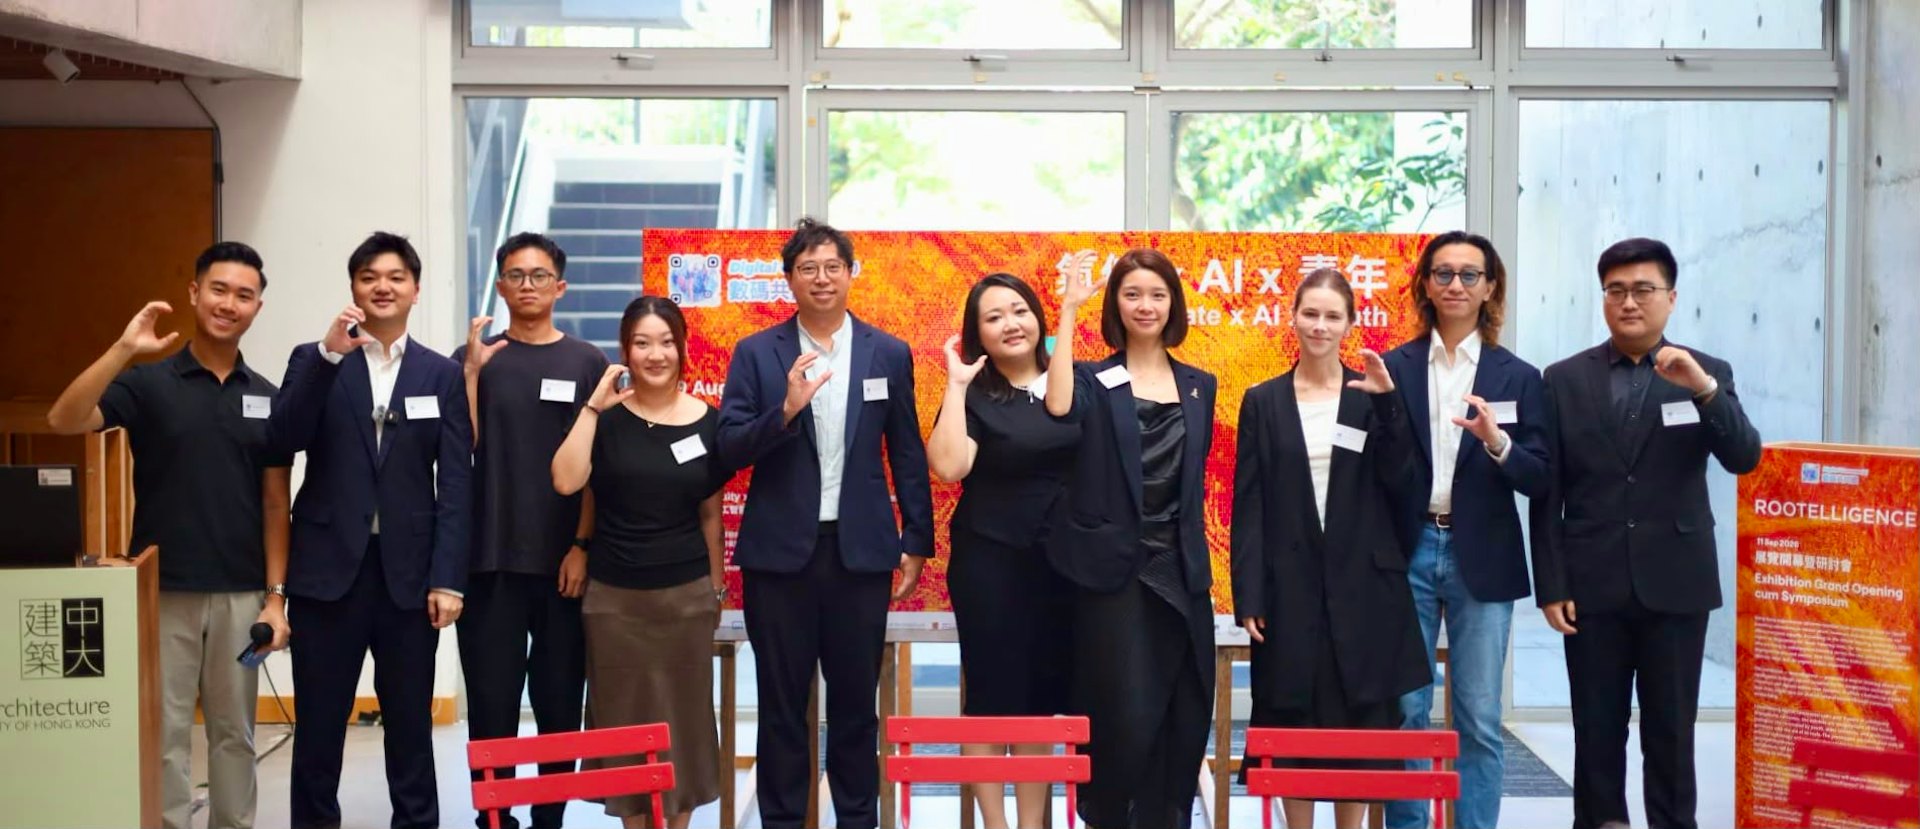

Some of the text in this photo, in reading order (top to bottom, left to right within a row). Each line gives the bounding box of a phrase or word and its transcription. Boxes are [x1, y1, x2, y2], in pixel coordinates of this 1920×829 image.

[729, 260, 778, 277] Digital
[1198, 259, 1243, 294] AI
[1257, 268, 1283, 294] x
[1229, 309, 1245, 326] x
[1252, 304, 1280, 326] AI
[1754, 498, 1917, 528] ROOTELLIGENCE
[1754, 572, 1904, 601] Exhibition Grand Opening
[1754, 590, 1848, 608] cum Symposium
[23, 601, 60, 677] 建築
[65, 600, 103, 676] 中大
[14, 720, 30, 731] OF
[33, 718, 73, 731] HONG
[75, 717, 111, 729] KONG
